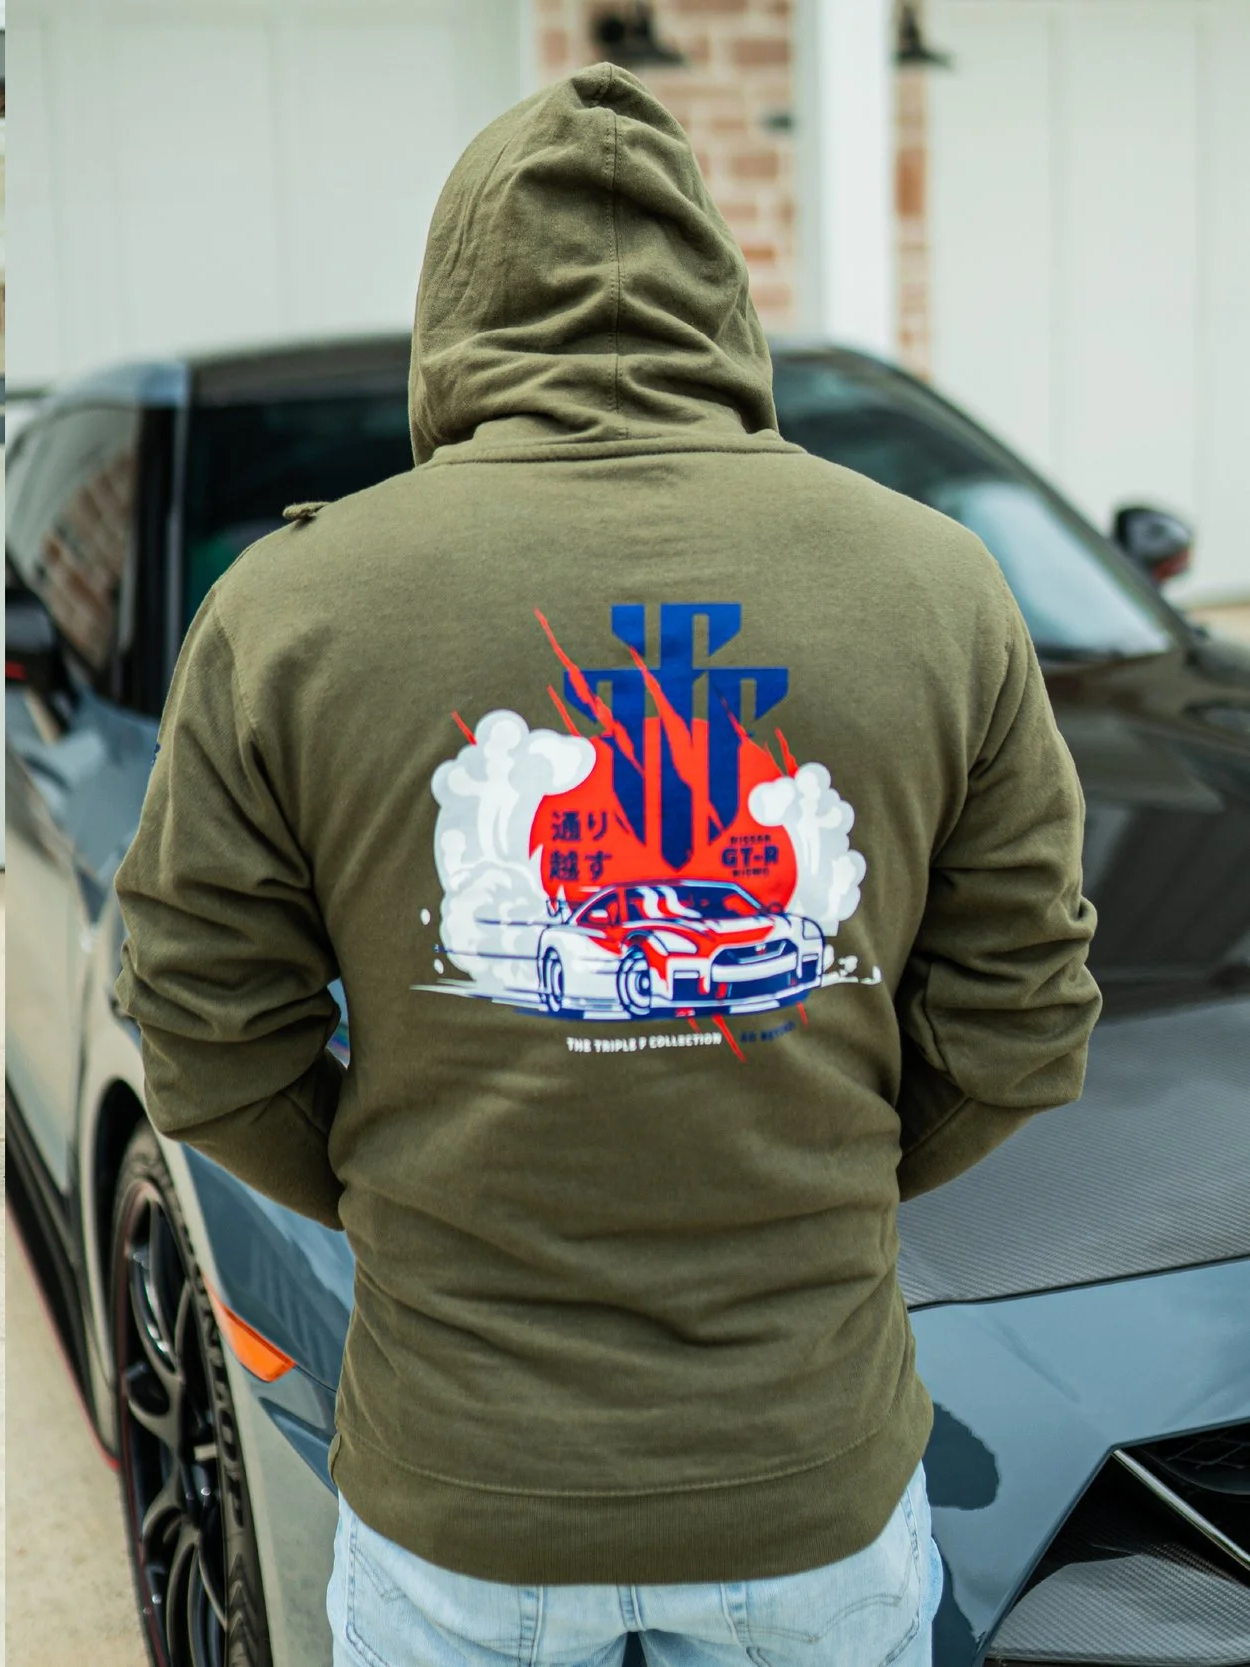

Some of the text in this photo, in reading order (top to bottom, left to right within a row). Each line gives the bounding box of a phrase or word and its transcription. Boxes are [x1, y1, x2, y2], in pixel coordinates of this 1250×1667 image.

[551, 810, 609, 842] 通り
[721, 845, 779, 867] GT-R
[566, 1036, 592, 1053] THE
[594, 1037, 637, 1053] TRIPLE
[649, 1032, 722, 1049] COLLECTION
